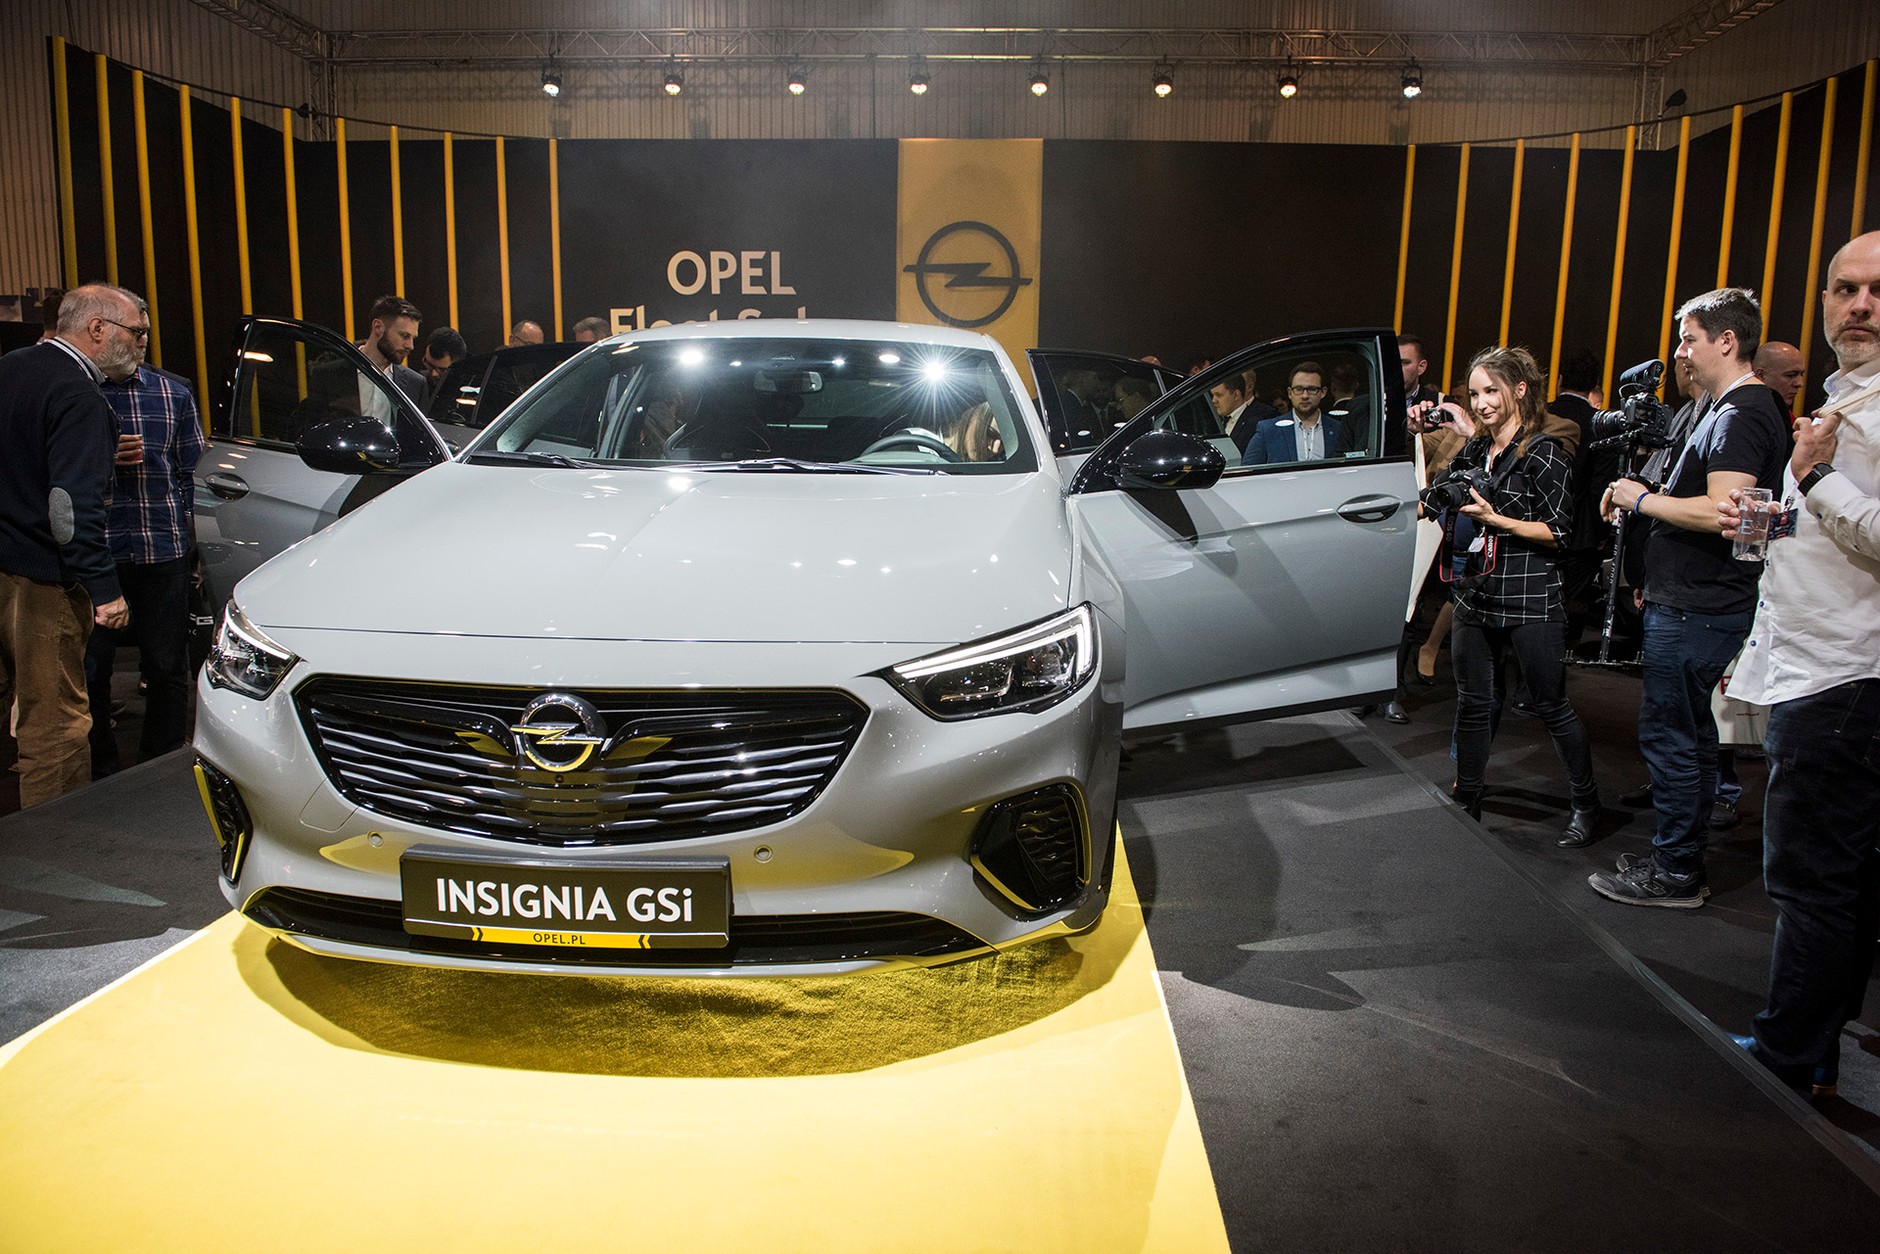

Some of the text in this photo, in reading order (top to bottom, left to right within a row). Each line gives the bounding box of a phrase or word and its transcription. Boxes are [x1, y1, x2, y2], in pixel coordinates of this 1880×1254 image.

[667, 250, 797, 295] OPEL
[436, 877, 693, 922] INSIGNIA GSi
[533, 933, 586, 945] OPEL.PL
